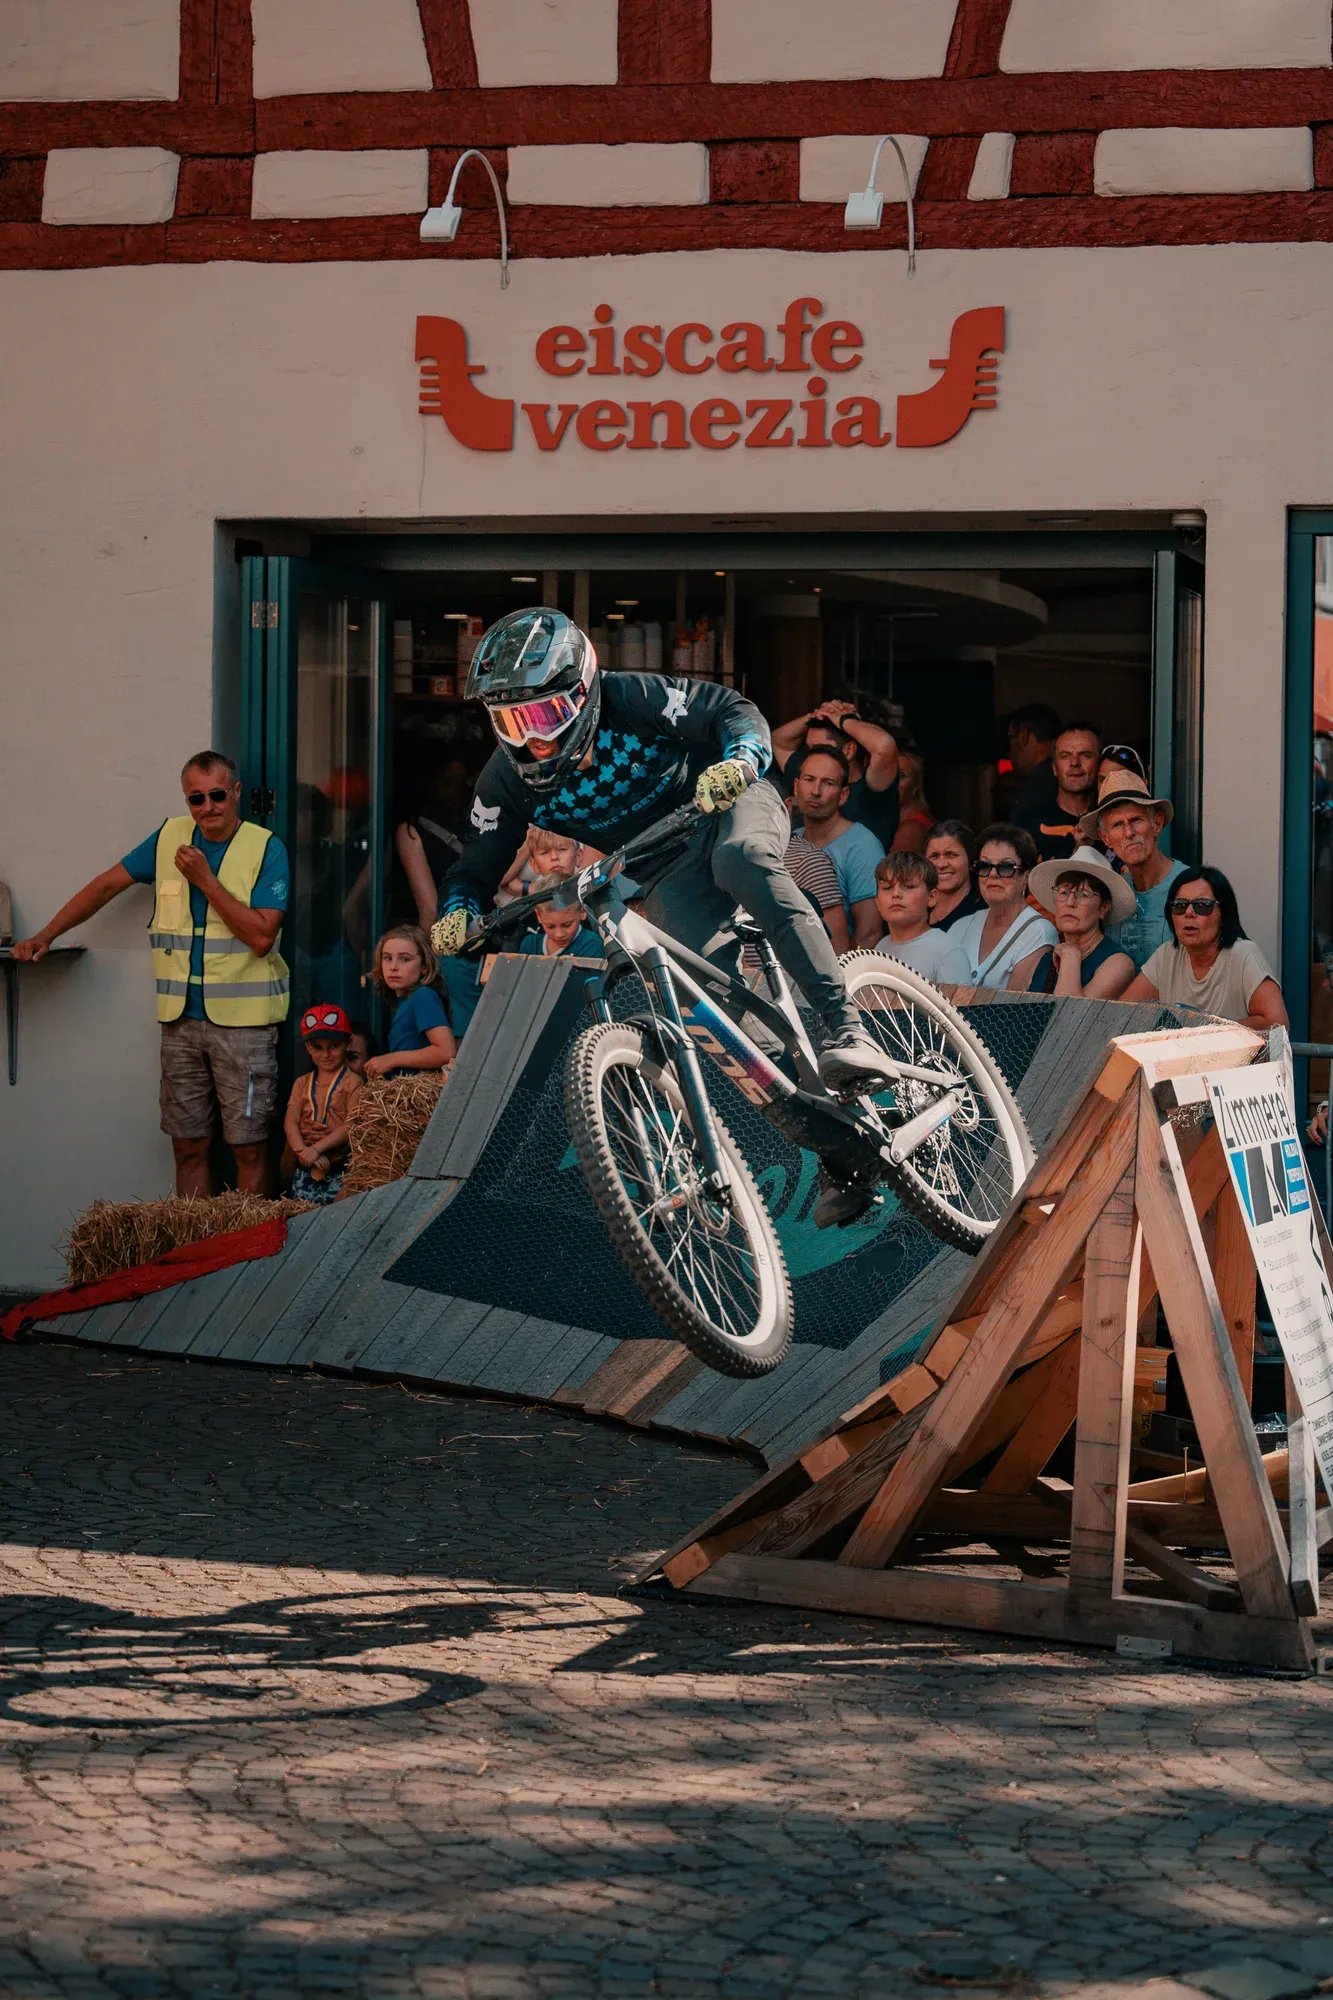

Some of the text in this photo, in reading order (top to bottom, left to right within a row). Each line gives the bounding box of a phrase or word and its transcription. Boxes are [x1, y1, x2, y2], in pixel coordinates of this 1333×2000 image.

[535, 297, 865, 377] eiscafe
[521, 376, 892, 451] venezia
[680, 1006, 774, 1105] SCO
